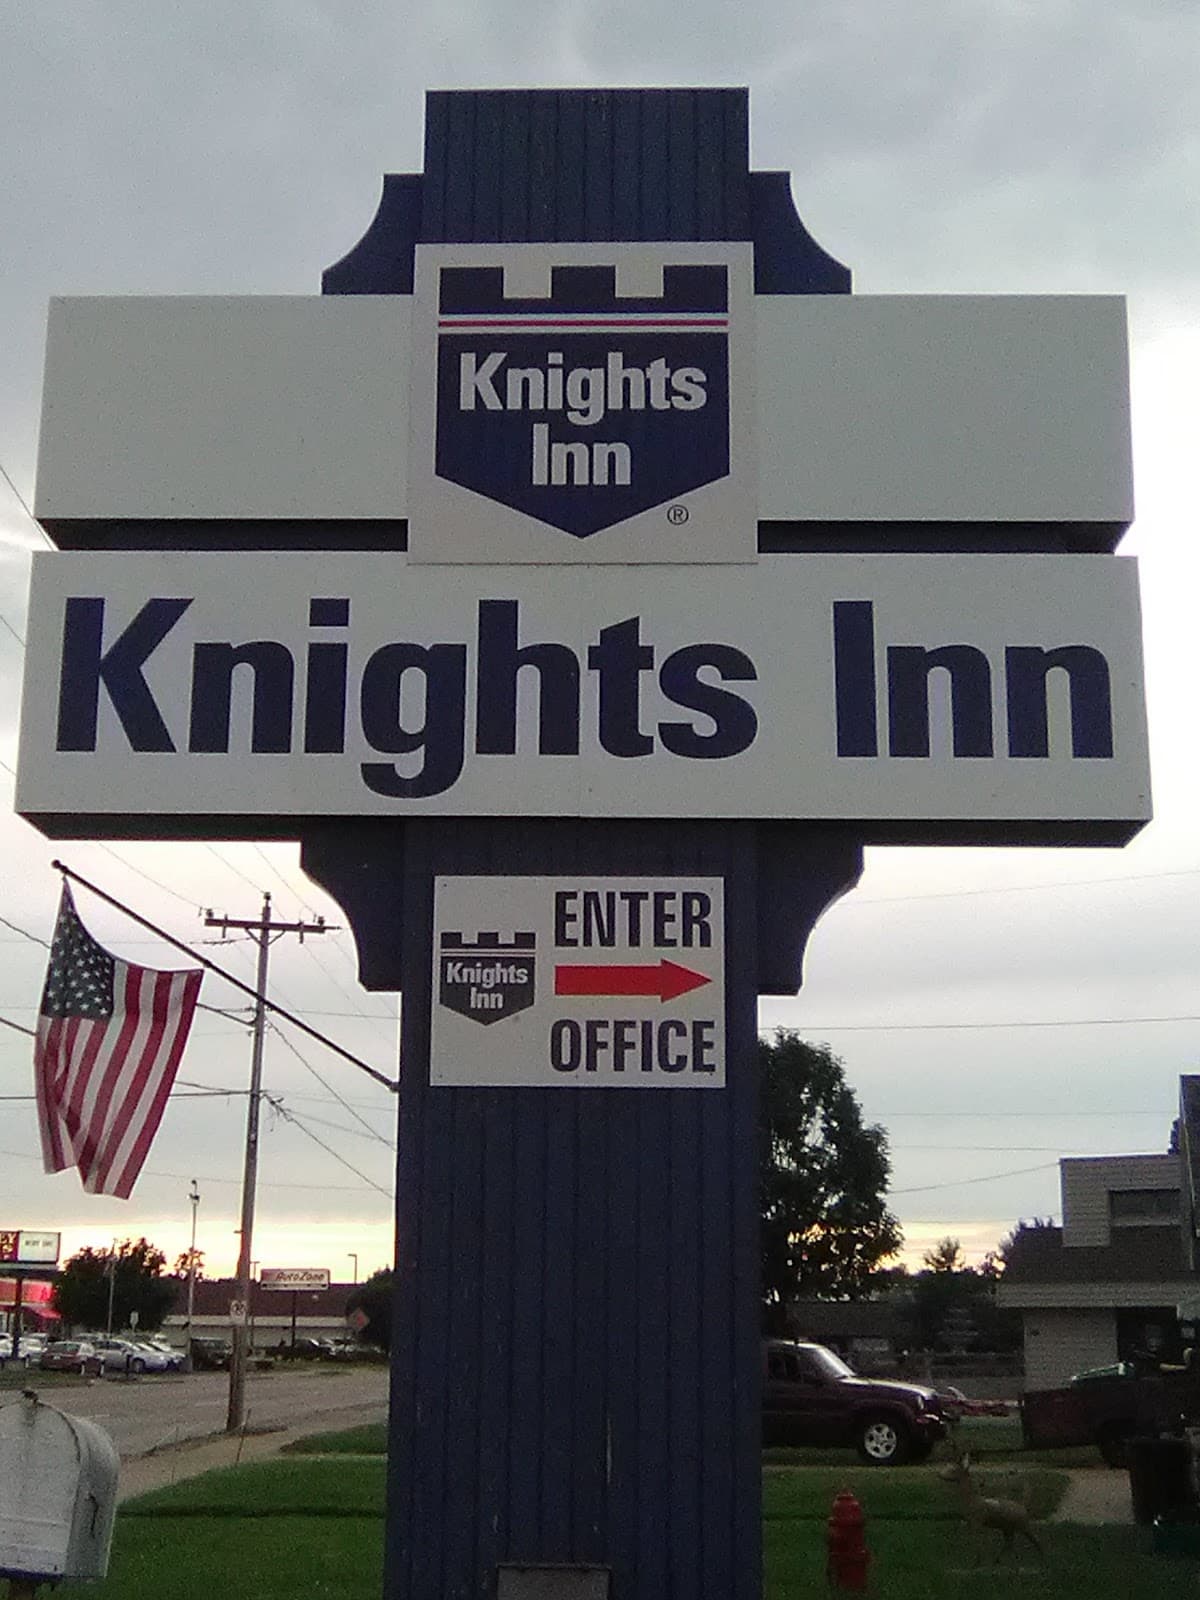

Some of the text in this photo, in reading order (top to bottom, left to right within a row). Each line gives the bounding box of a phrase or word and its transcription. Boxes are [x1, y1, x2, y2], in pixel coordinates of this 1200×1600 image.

[459, 352, 708, 426] Knights
[532, 423, 632, 486] Inn
[56, 597, 1113, 799] Knights Inn
[554, 891, 712, 948] ENTER
[446, 963, 529, 987] Knights
[470, 987, 503, 1009] Inn
[551, 1018, 716, 1072] OFFICE
